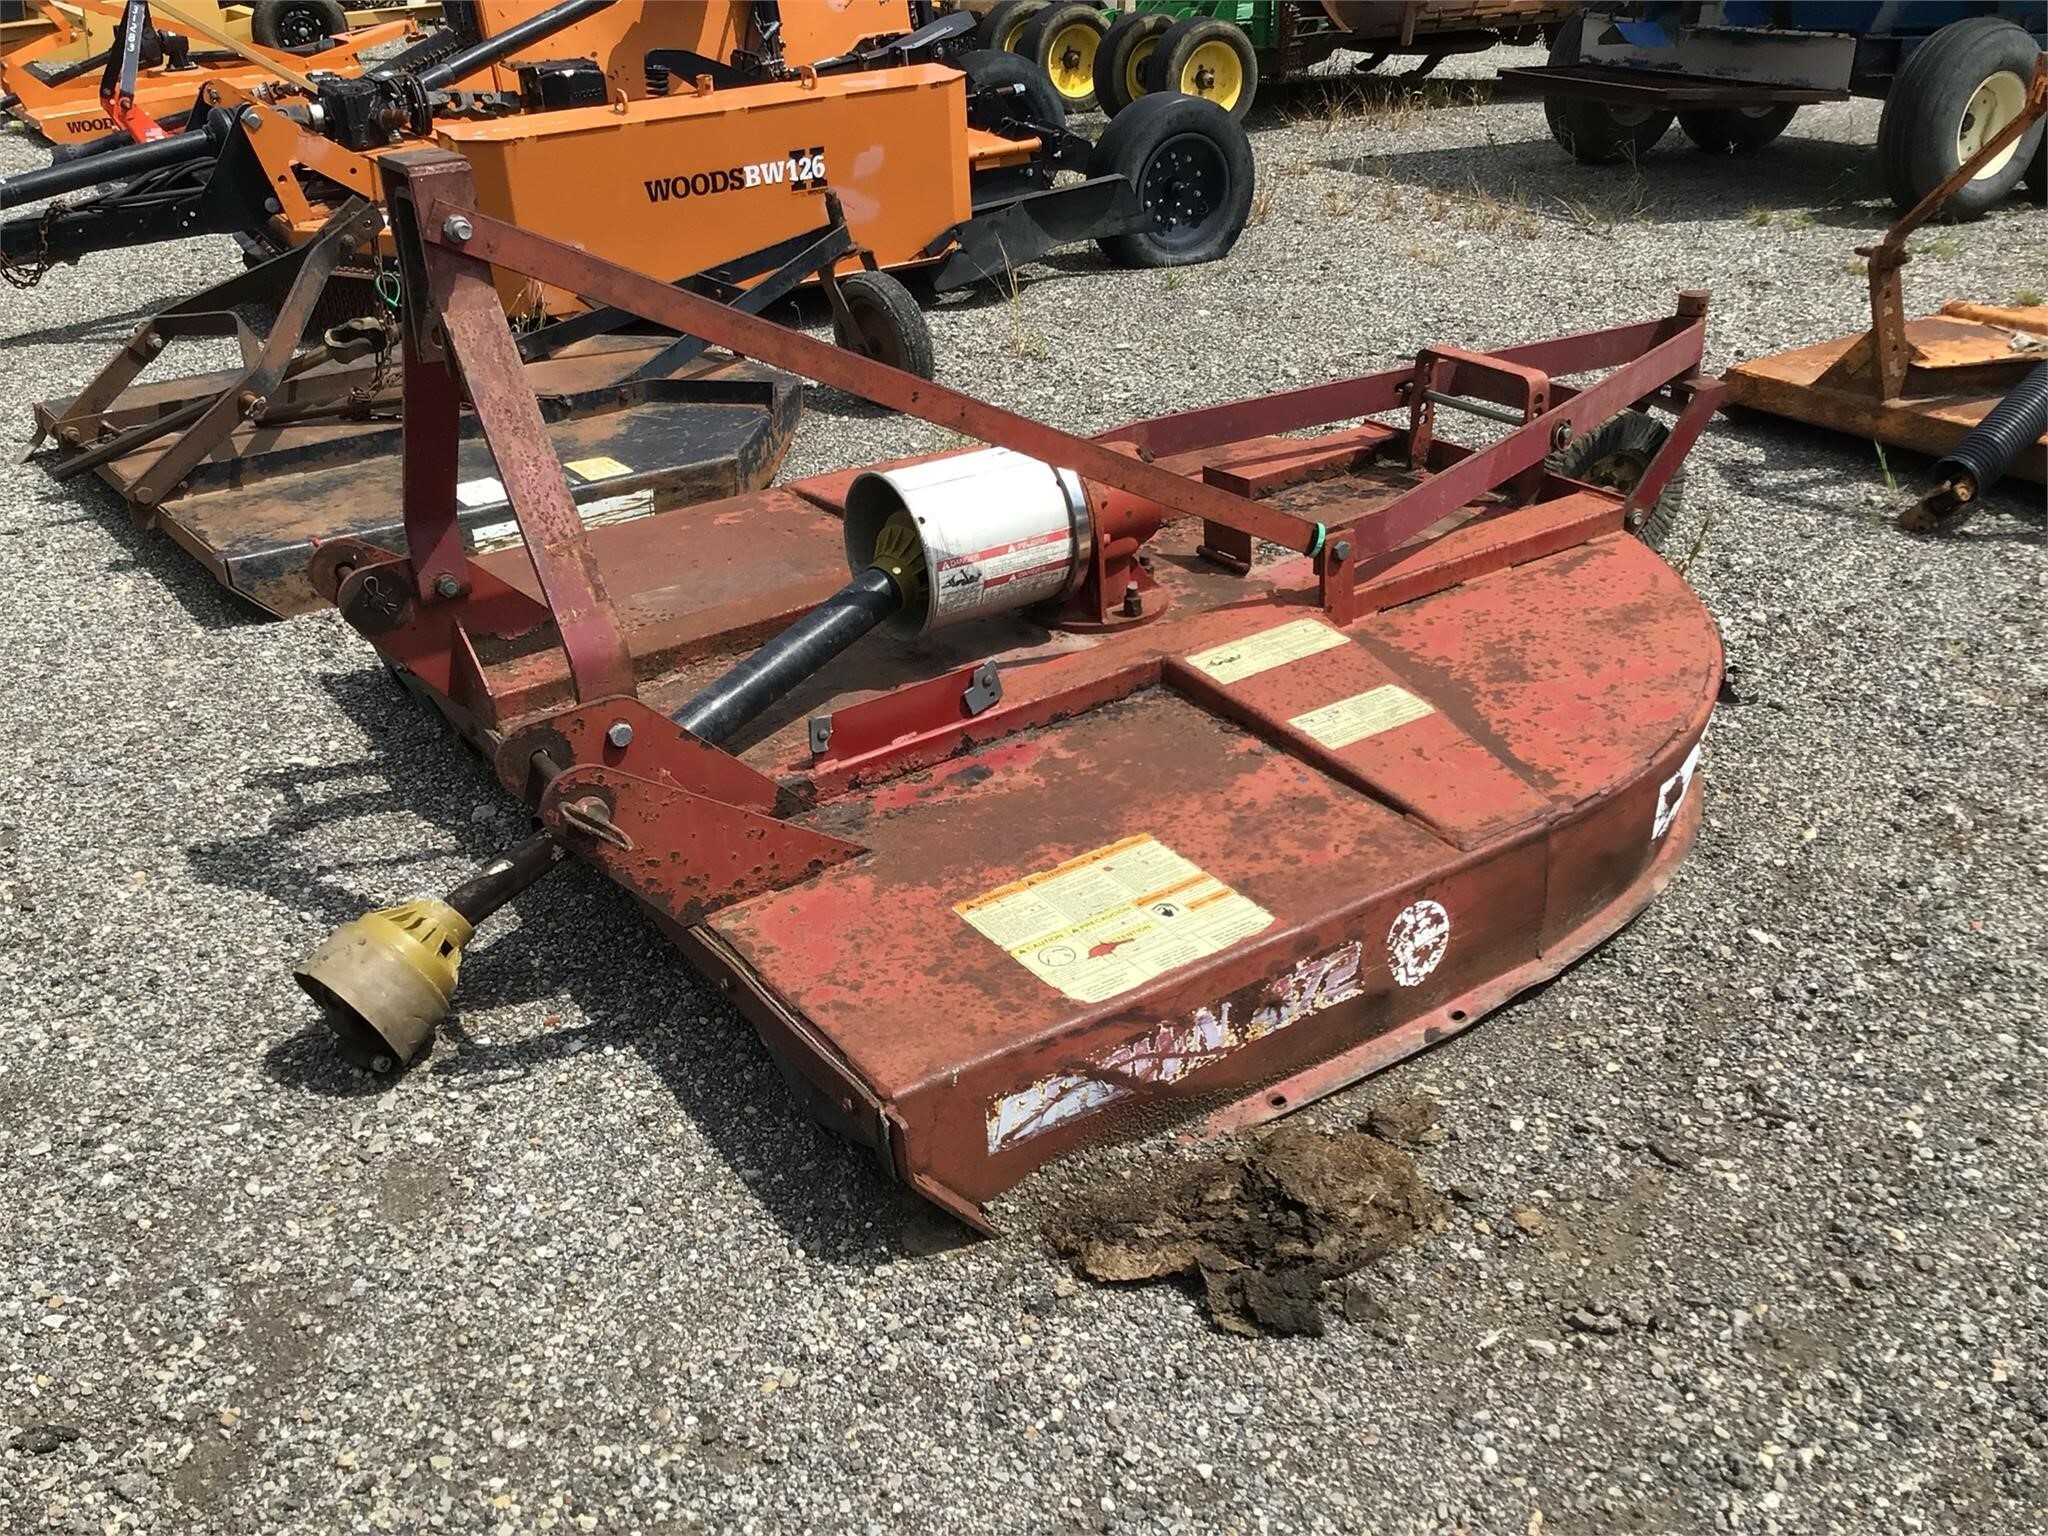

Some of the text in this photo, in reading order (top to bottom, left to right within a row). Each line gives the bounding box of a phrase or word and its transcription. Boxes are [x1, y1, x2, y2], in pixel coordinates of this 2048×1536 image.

[127, 4, 139, 53] 31283
[66, 117, 115, 134] WOOD
[644, 167, 745, 203] WOODS
[743, 155, 826, 188] BW126
[1026, 932, 1064, 951] CAUTION
